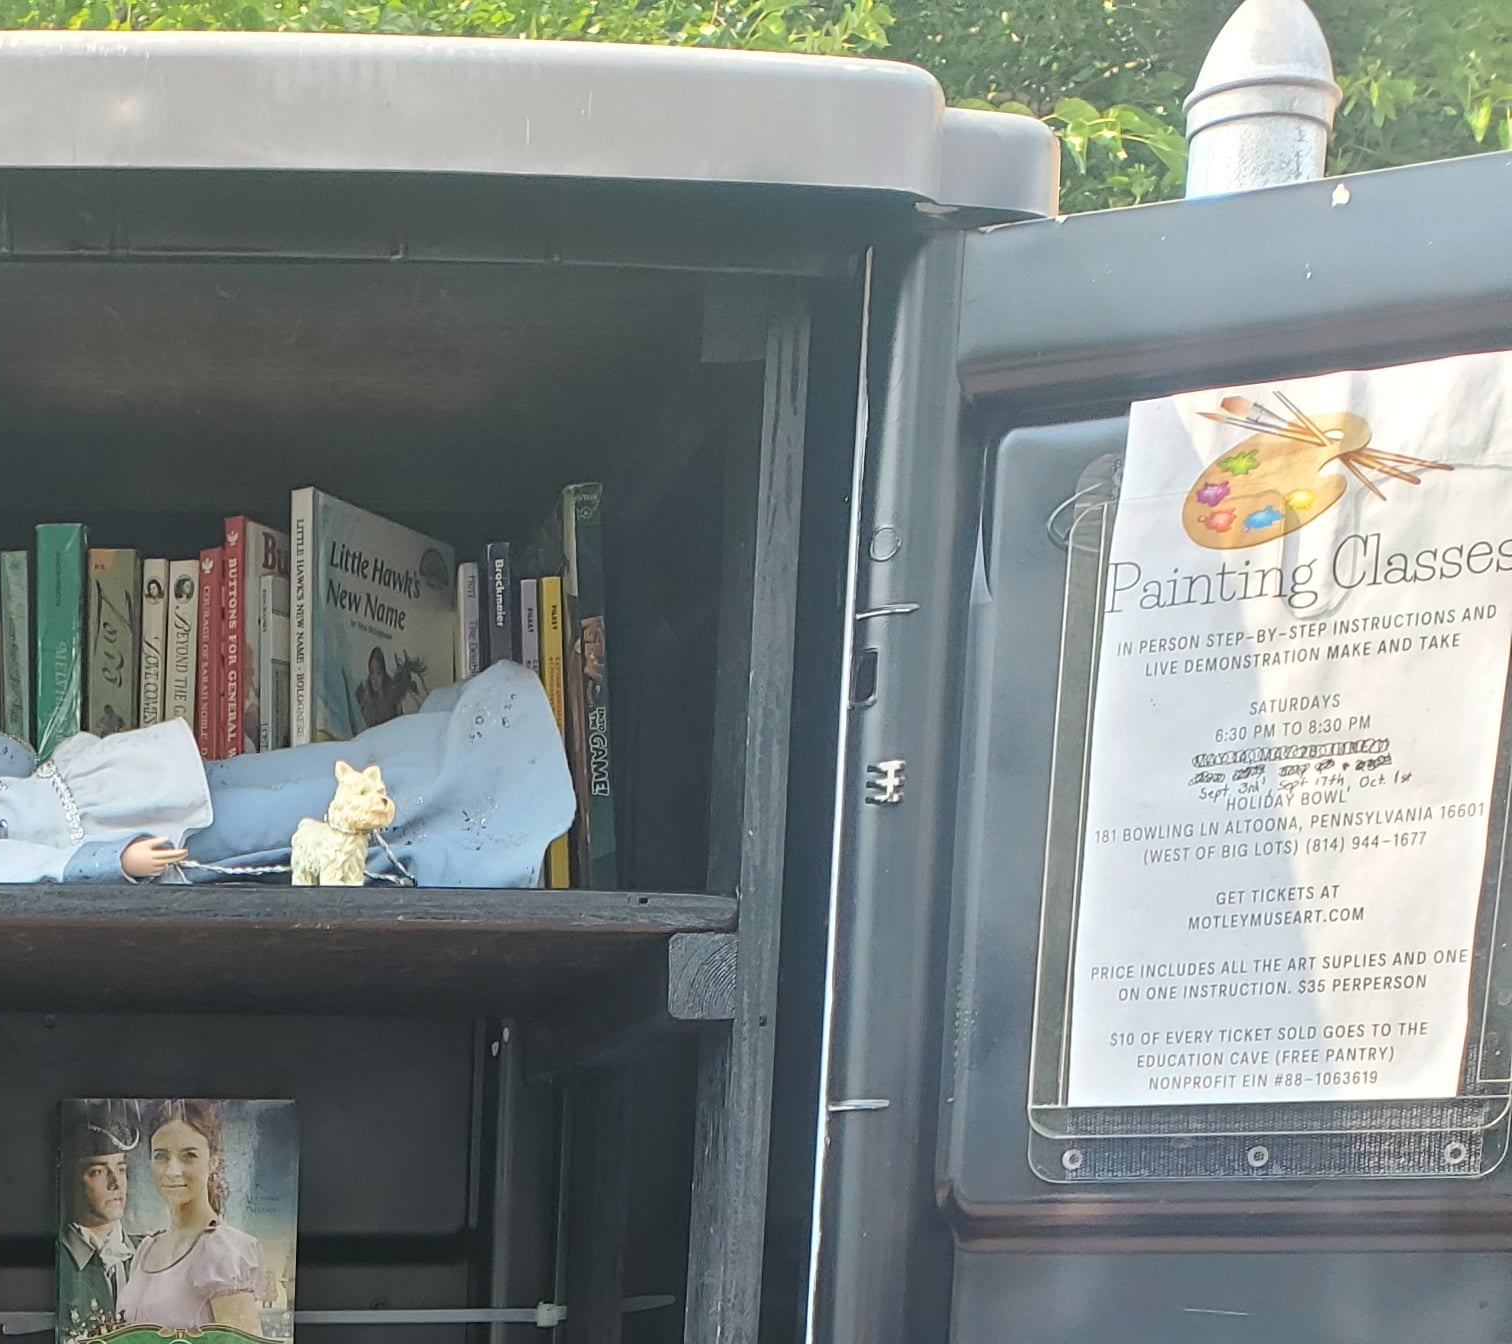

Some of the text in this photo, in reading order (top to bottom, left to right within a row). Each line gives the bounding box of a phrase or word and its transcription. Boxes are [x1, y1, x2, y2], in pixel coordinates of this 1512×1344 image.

[330, 541, 420, 600] Little Hawk's
[1104, 533, 1512, 613] Painting Classes
[326, 579, 406, 631] New Name
[493, 559, 506, 627] Brockmeier
[227, 559, 237, 741] BUTTONS FOR GENERAL
[296, 519, 305, 737] LITTLE HAWK'S NEW NAME BOLOGNESE
[1117, 604, 1497, 656] IN PERSON STEP-BY-STEP INSTRUCTIONS AND
[200, 586, 210, 740] COURAGE OF SARAH NOBLE
[1145, 633, 1461, 677] LIVE DEMONSTRATION MAKE AND TAKE
[1249, 694, 1340, 715] SATURDAYS
[1215, 715, 1370, 743] 6:30 PM TO 8:30 PM
[591, 732, 610, 797] GAME!
[1226, 790, 1345, 811] HOLIDAY BOWL
[1096, 803, 1484, 843] 181 BOWLING LN ALTOONA, PENNSYLVANIA 16601
[1144, 831, 1427, 865] (WEST OF BIG LOTS) (814) 944-1677
[1216, 885, 1340, 906] GET TICKETS AT
[1188, 907, 1364, 930] MOTLEYMUSEART.COM
[1137, 1046, 1394, 1068] EDUCATION CAVE (FREE PANTRY)
[1149, 1071, 1377, 1090] NONPROFIT EIN #88-1063619
